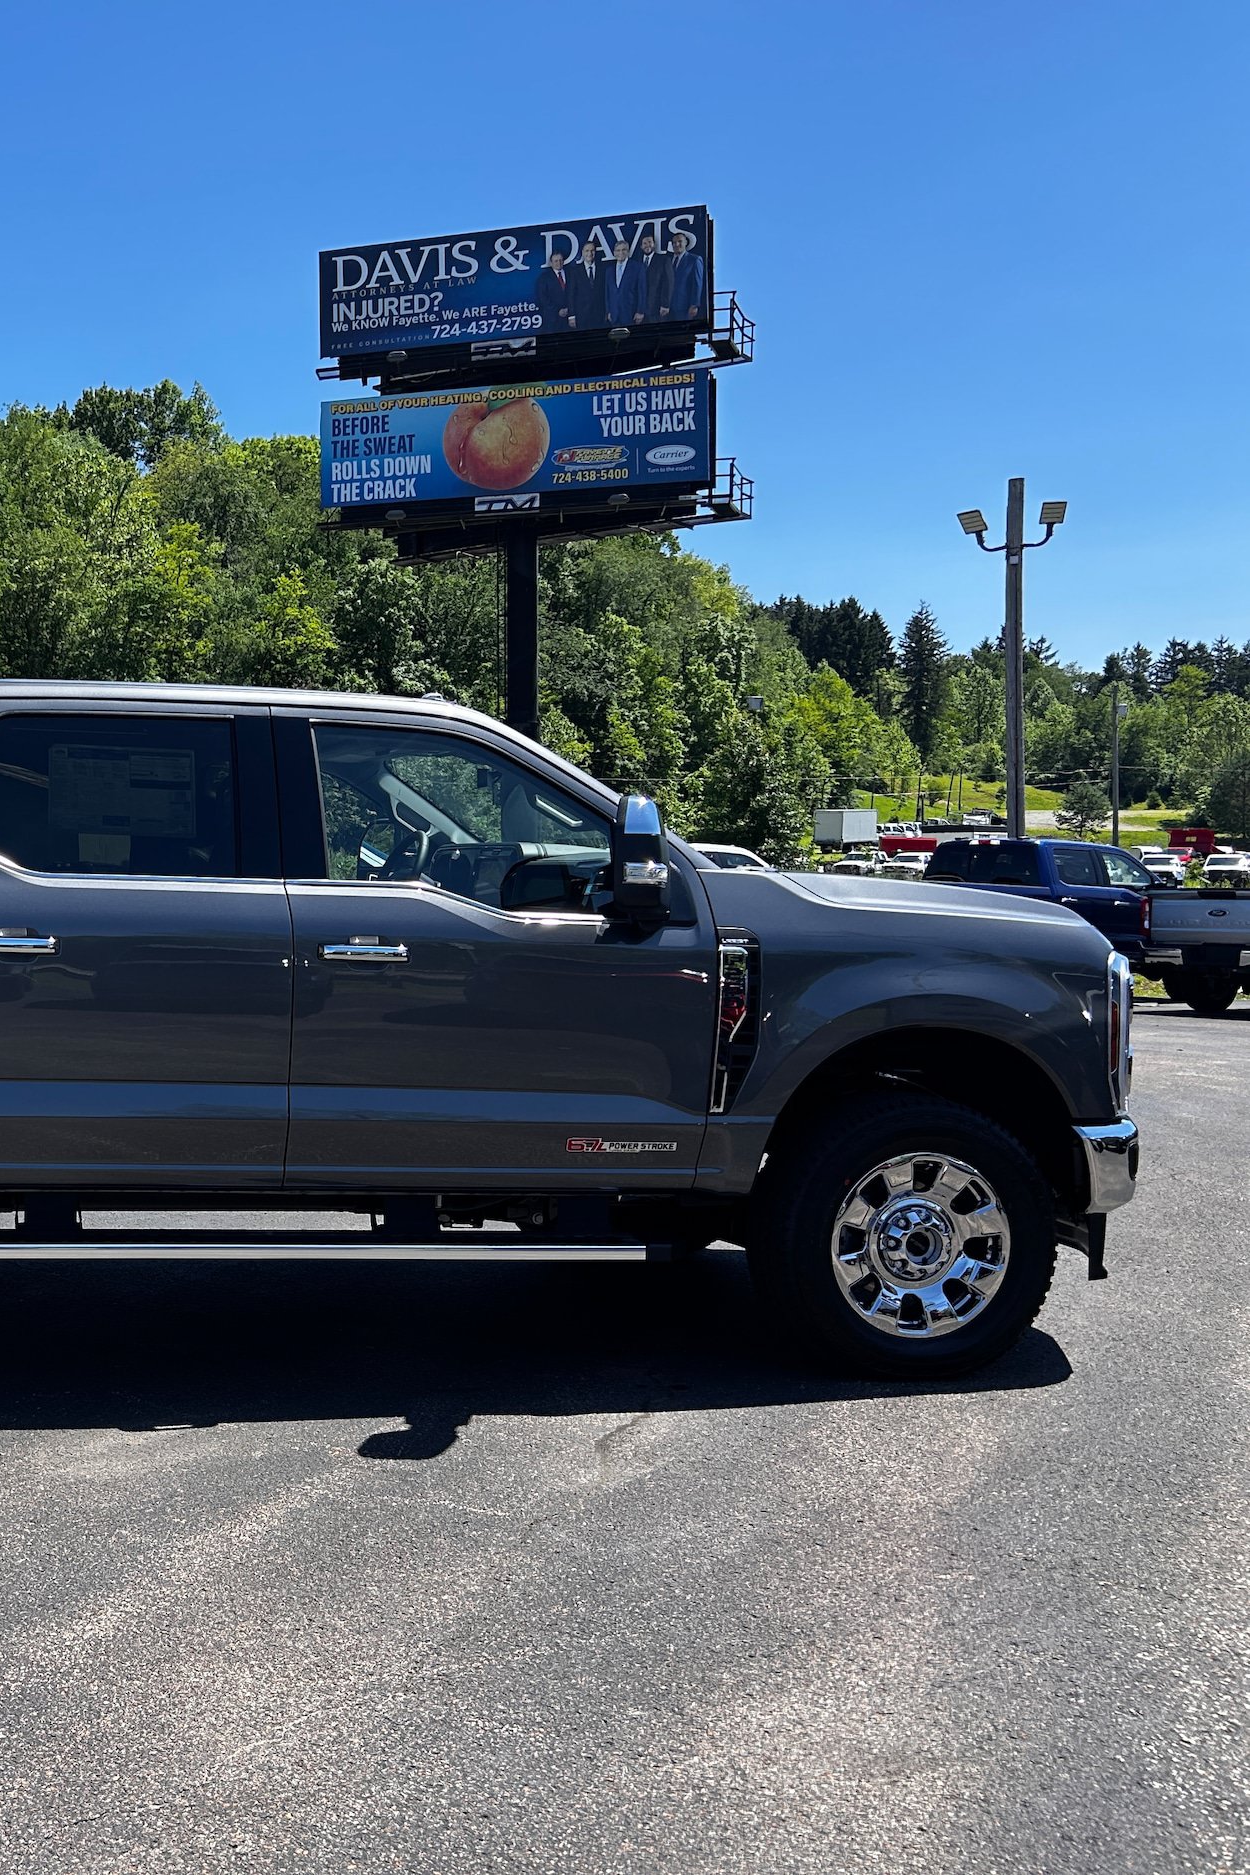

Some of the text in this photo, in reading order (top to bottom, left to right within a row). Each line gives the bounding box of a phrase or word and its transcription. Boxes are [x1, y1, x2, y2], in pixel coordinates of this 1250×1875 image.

[332, 214, 697, 292] DAVIS & DAVIS
[332, 276, 477, 300] ATTORNEYS AT LAW
[332, 291, 444, 323] INJURED?
[332, 302, 539, 333] We KNOW Fayette. We ARE Fayette.
[431, 314, 543, 339] 724-437-2799
[331, 334, 430, 350] FREE CONSULTATION
[331, 404, 354, 415] FOR
[356, 402, 378, 413] ALL
[379, 401, 396, 411] OF
[396, 398, 429, 409] YOUR
[490, 387, 543, 400] COOLING
[545, 384, 572, 395] AND
[574, 377, 648, 393] ELECTRICAL
[649, 373, 695, 387] NEEDS!
[592, 387, 695, 416] LET US HAVE
[331, 414, 390, 437] BEFORE
[600, 409, 696, 438] YOUR BACK
[331, 433, 415, 459] THE SWEAT
[653, 448, 690, 461] Carrier
[331, 454, 431, 481] ROLLS DOWN
[551, 467, 629, 484] 724-438-5400
[675, 464, 696, 473] experts
[331, 477, 417, 504] THE CRACK
[608, 1142, 639, 1151] POWER
[640, 1142, 675, 1151] STROKE
